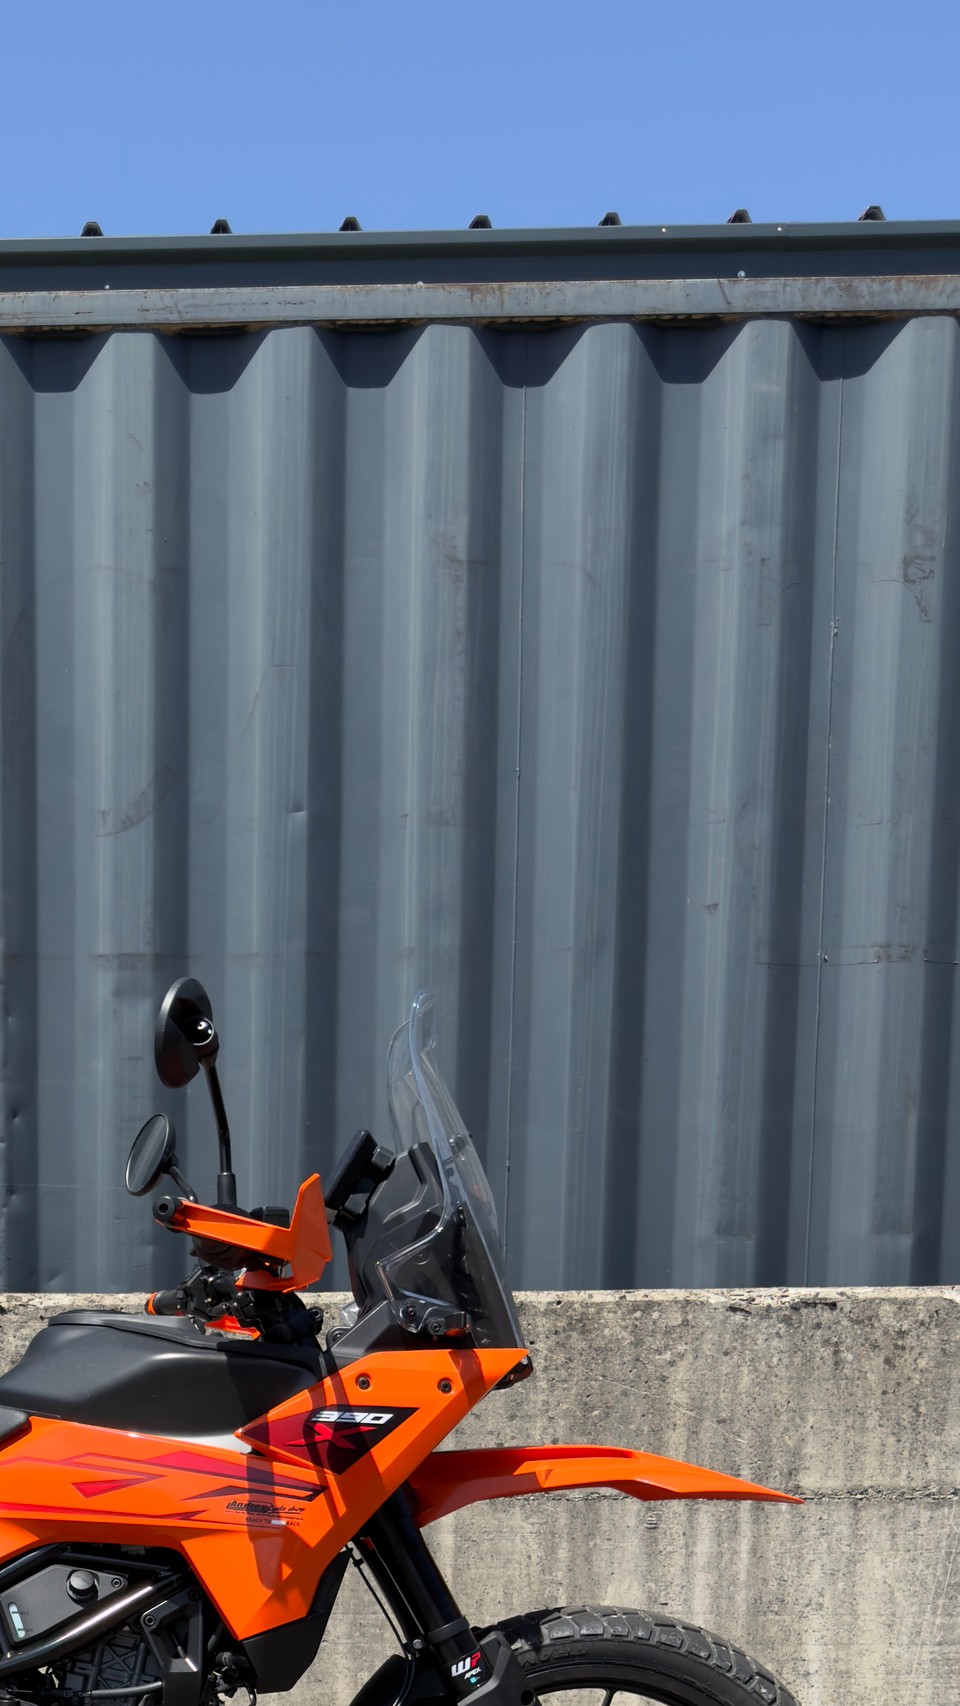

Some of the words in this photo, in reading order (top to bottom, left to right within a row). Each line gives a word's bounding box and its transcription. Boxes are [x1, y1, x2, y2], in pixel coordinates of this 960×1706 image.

[311, 1410, 394, 1425] 390
[451, 1651, 481, 1678] WP
[464, 1667, 481, 1680] APEX
